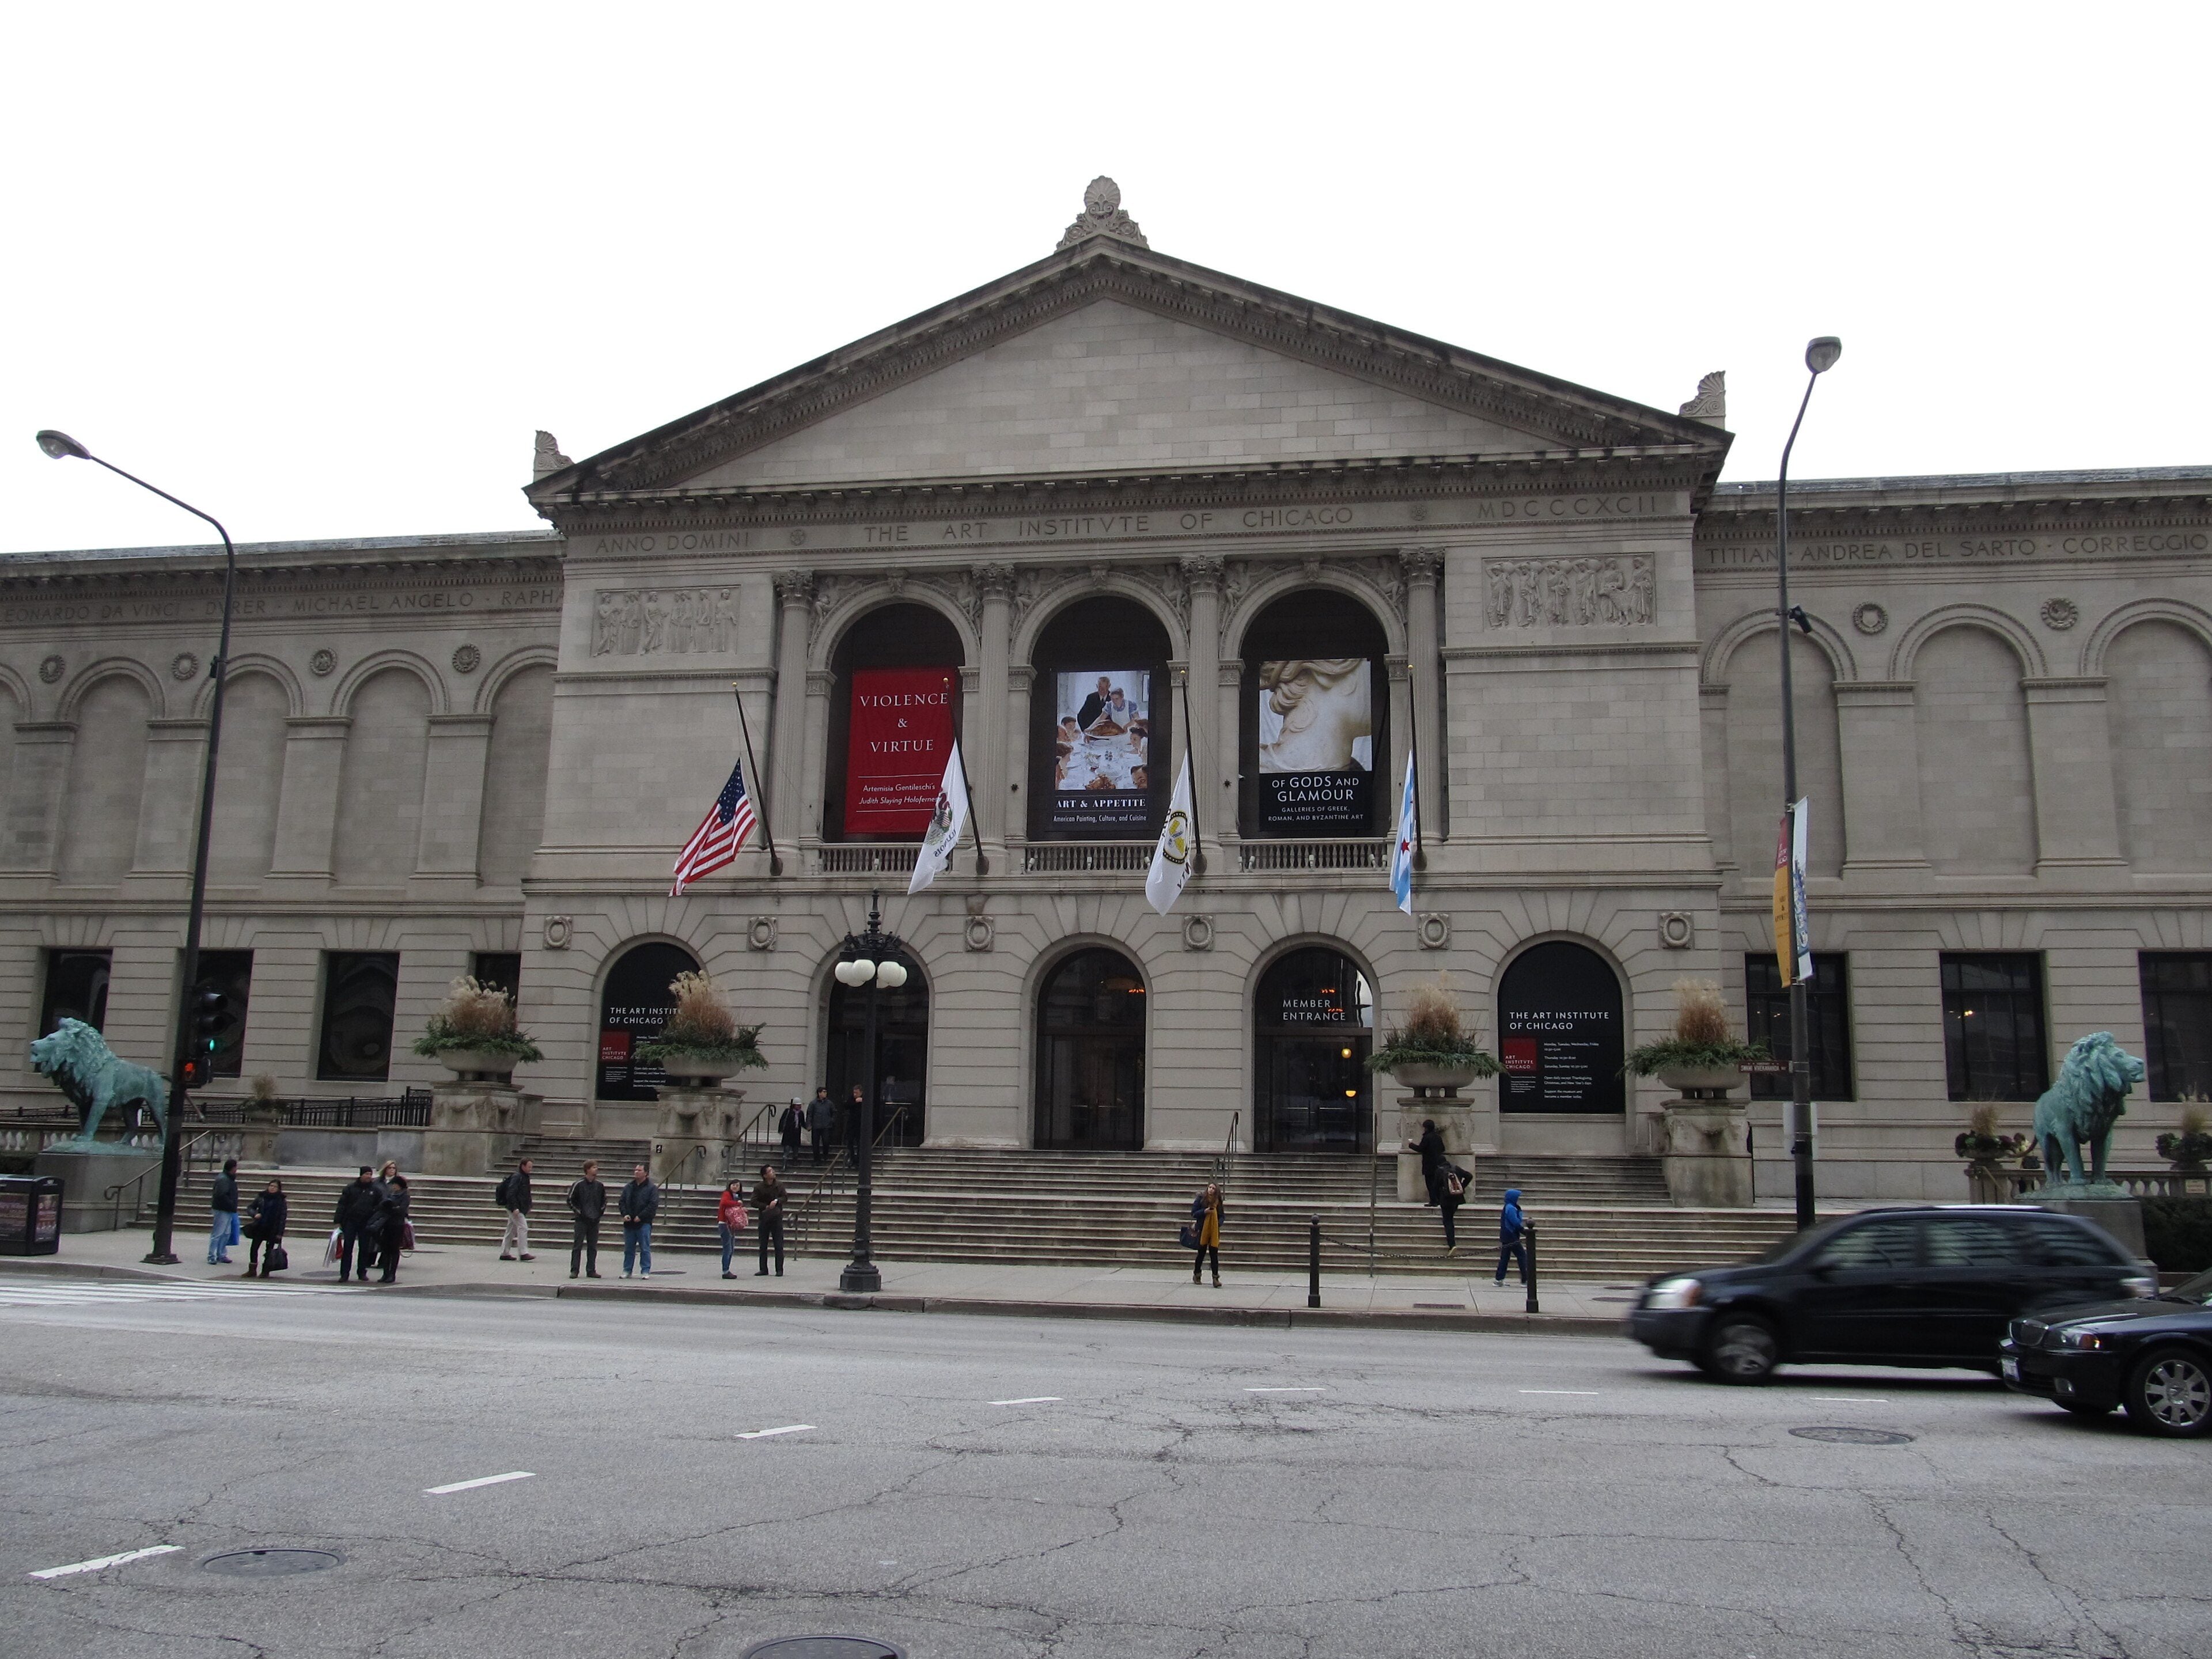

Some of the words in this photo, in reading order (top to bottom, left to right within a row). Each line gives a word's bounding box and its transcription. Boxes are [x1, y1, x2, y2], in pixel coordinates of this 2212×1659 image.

[1478, 496, 1656, 518] MDCCCXCII
[864, 525, 909, 542] THE
[942, 522, 987, 539] ART
[1018, 516, 1150, 536] INSTITVTE
[1180, 513, 1213, 529] OF
[1243, 507, 1353, 528] CHICAGO
[596, 536, 656, 553] ANNO
[666, 532, 749, 550] DOMINI
[2062, 533, 2209, 554] CORREGGIO
[1705, 546, 1779, 563] TITIAN
[1801, 544, 1893, 561] ANDREA
[1904, 542, 1950, 559] DEL
[1960, 539, 2036, 557] SARTO
[293, 595, 379, 613] MICHAEL
[389, 592, 474, 609] ANGELO
[132, 602, 180, 618] VINCI
[860, 693, 948, 707] VIOLENCE
[897, 718, 908, 728] &
[870, 739, 933, 752] VIRTUE
[1272, 779, 1285, 788] OF
[1290, 776, 1331, 788] GODS
[1335, 778, 1359, 786] AND
[880, 797, 902, 805] Slaying
[1278, 789, 1354, 802] GLAMOUR
[1056, 800, 1077, 808] ART
[1080, 800, 1088, 808] &
[1092, 798, 1146, 807] APPETITE
[1283, 999, 1331, 1007] MEMBER
[1283, 1012, 1346, 1020] ENTRANCE
